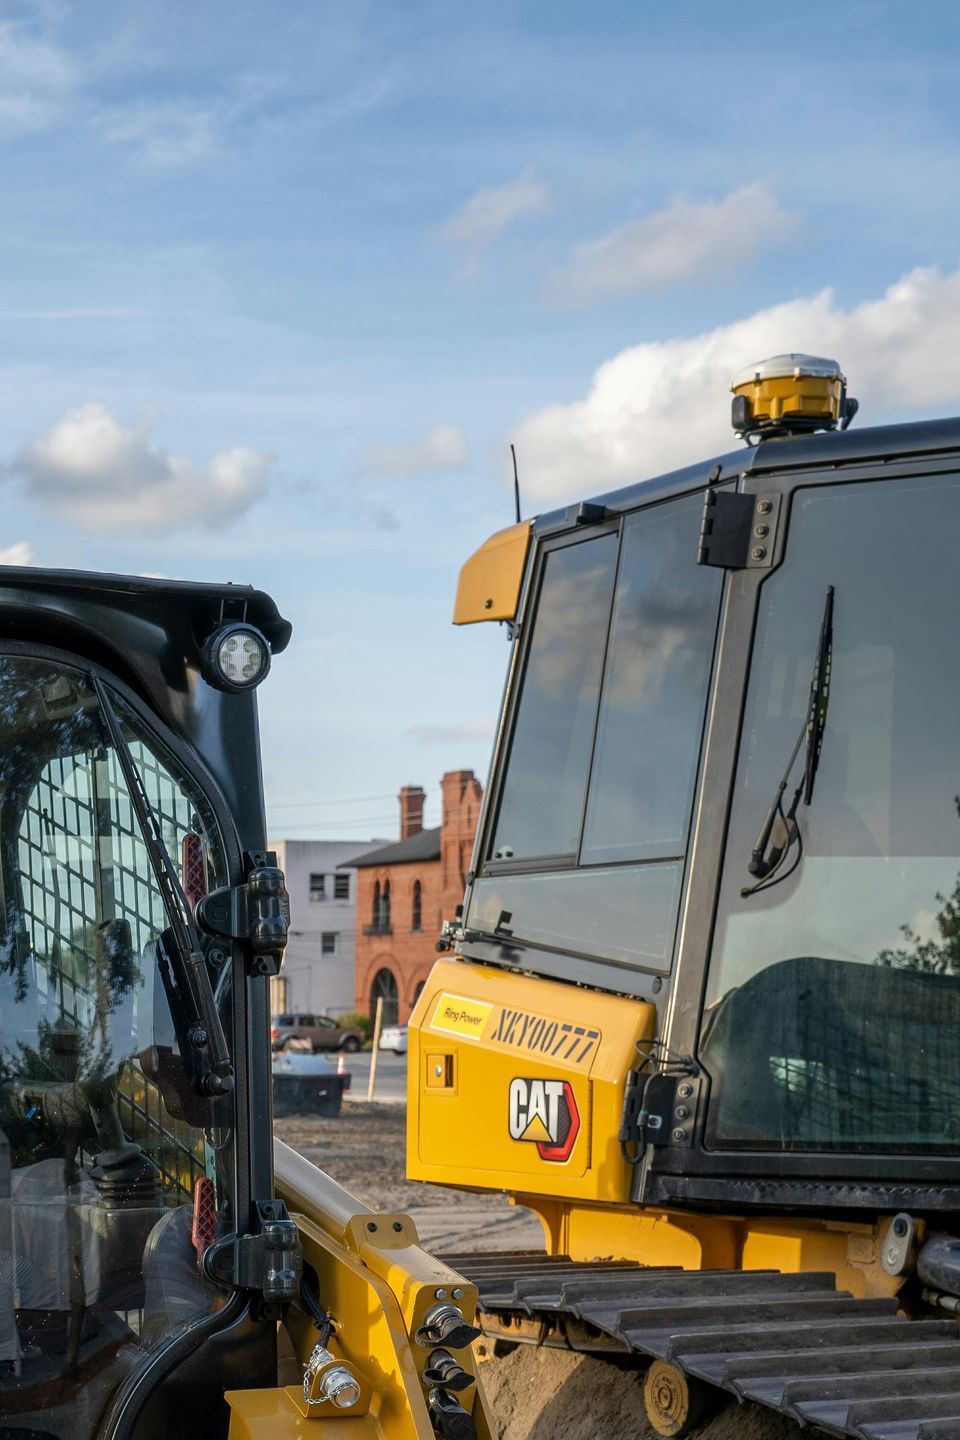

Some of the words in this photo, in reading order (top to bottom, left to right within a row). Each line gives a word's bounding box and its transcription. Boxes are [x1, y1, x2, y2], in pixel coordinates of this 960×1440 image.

[443, 1007, 460, 1022] Ring
[460, 1011, 482, 1026] Power
[490, 1008, 600, 1064] XKY00777
[509, 1078, 564, 1143] CAT
